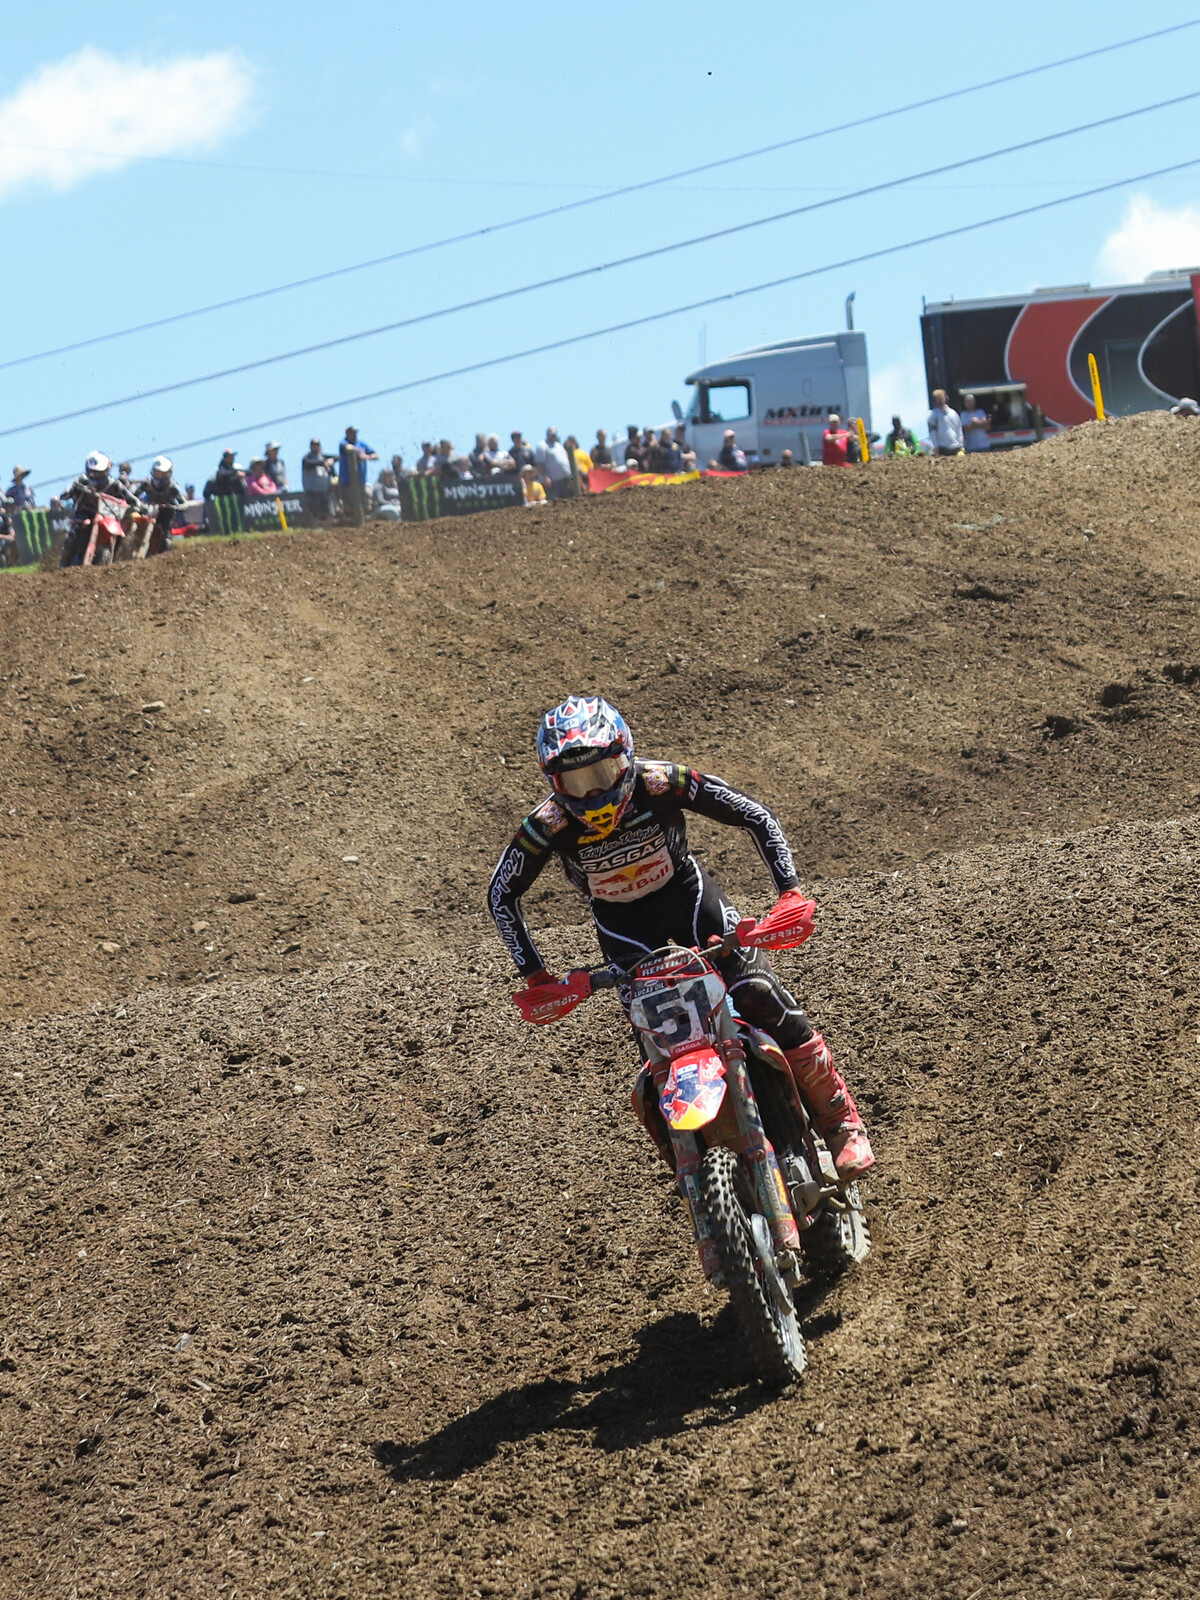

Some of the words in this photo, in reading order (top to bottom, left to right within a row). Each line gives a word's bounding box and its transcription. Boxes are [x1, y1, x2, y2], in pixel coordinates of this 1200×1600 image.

[444, 482, 516, 500] MONSTER
[582, 836, 666, 872] GASGAS
[595, 883, 635, 896] Red
[636, 864, 670, 890] Bull
[753, 925, 804, 946] ACERBIS
[634, 986, 655, 998] LUCAS
[654, 982, 665, 991] OIL
[530, 994, 580, 1017] ACERBIS
[640, 979, 713, 1047] 51
[675, 1042, 701, 1054] GASGA
